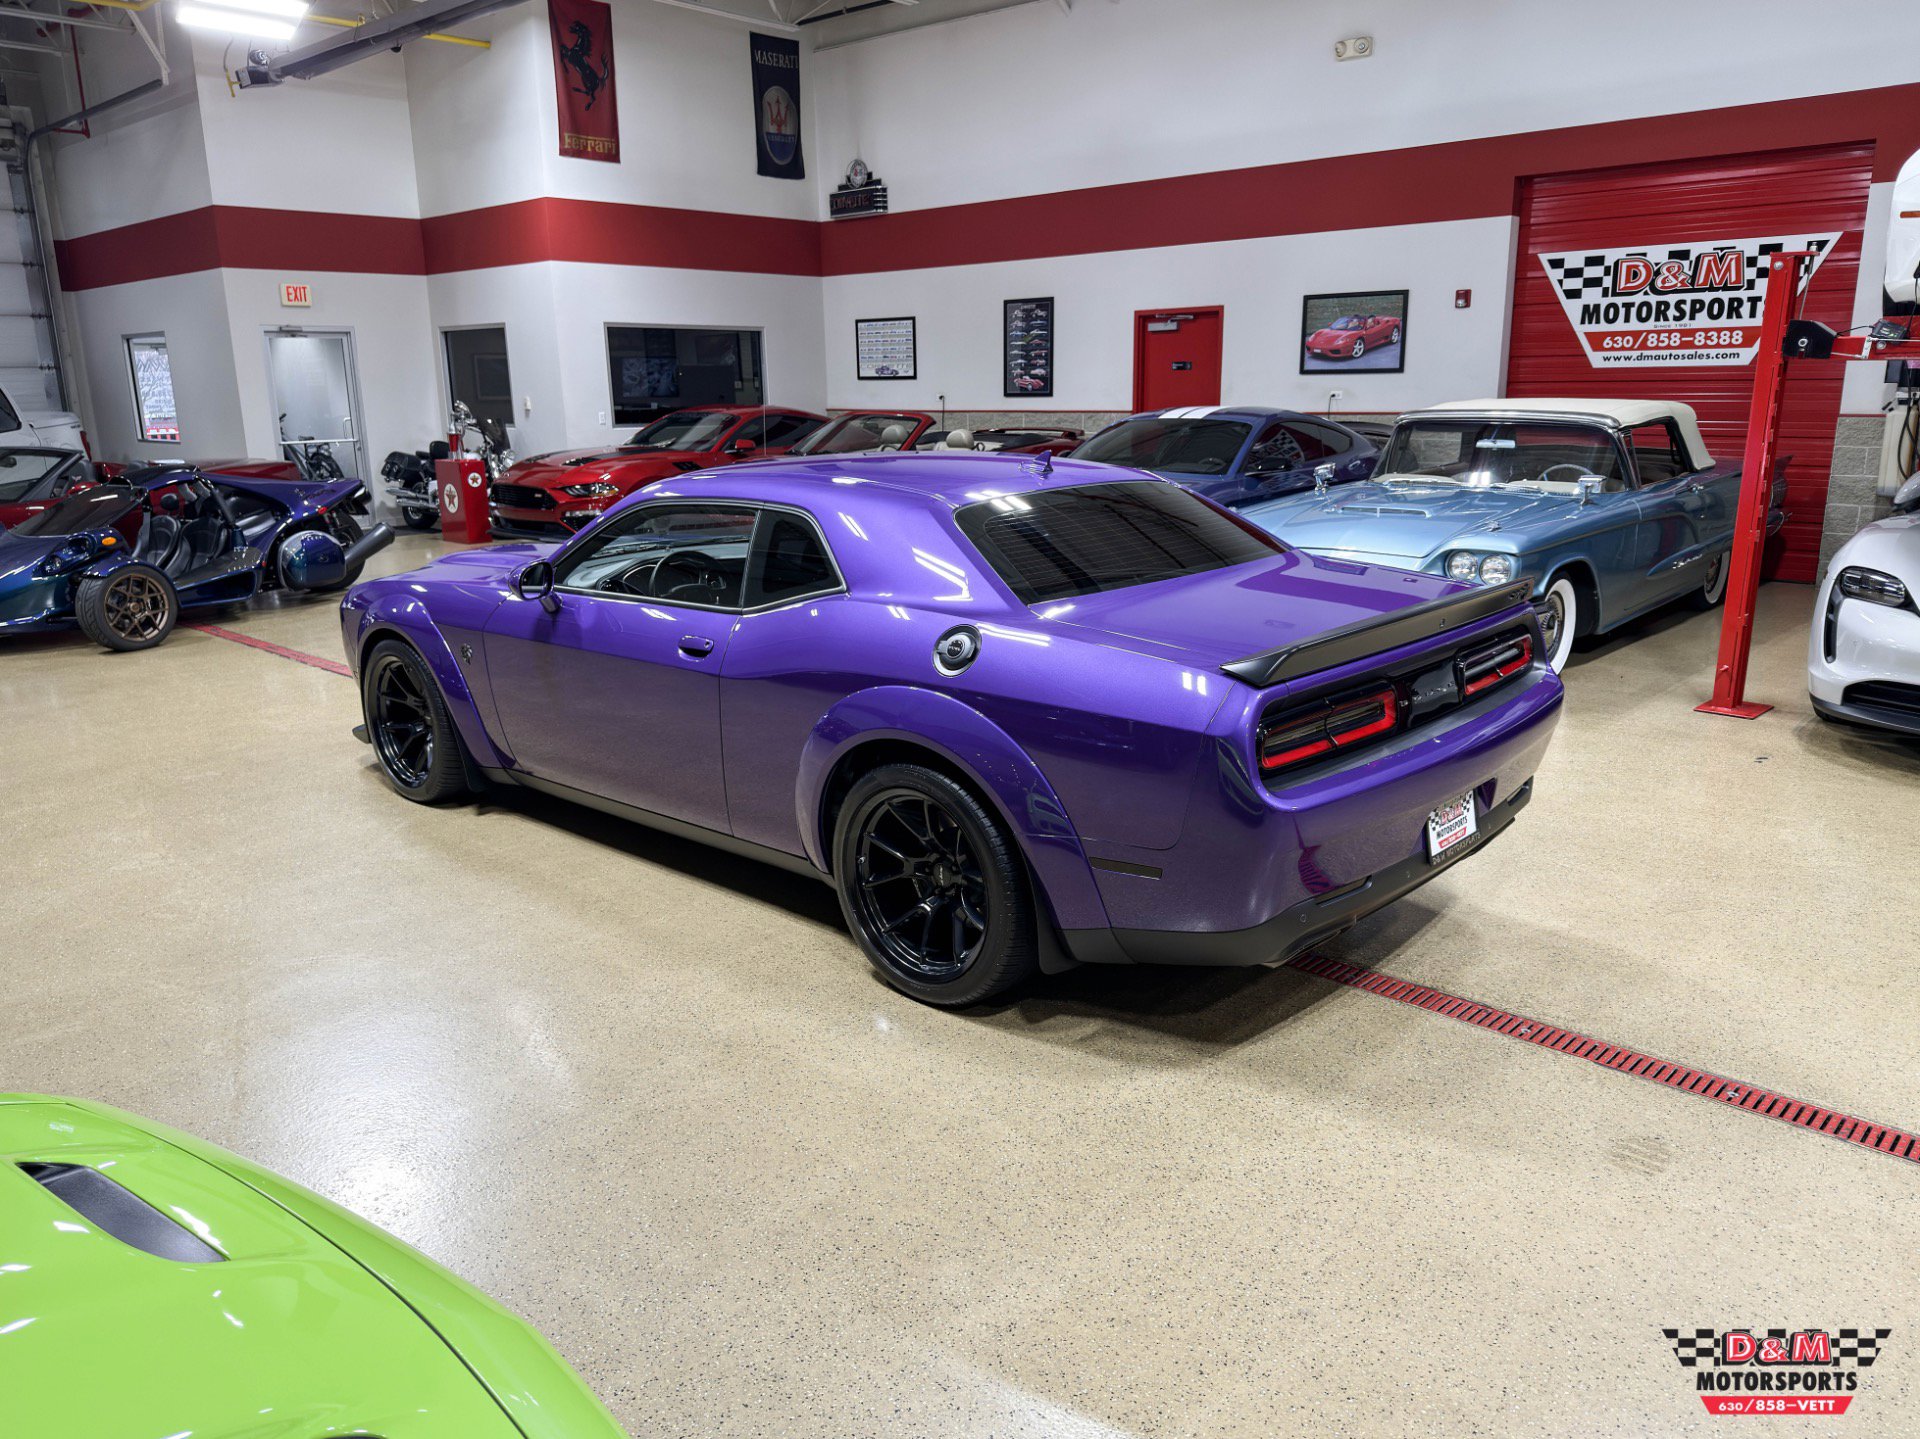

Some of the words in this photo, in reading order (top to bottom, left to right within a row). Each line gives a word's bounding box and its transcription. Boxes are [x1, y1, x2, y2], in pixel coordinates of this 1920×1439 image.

[754, 49, 799, 69] MASERATI
[564, 132, 617, 154] Ferrari
[1614, 250, 1745, 294] D&M
[286, 285, 307, 302] EXIT
[1580, 295, 1766, 325] MOTORSPORT
[1602, 329, 1743, 349] 630/858-8388
[1602, 350, 1741, 363] www.dmautosales.com
